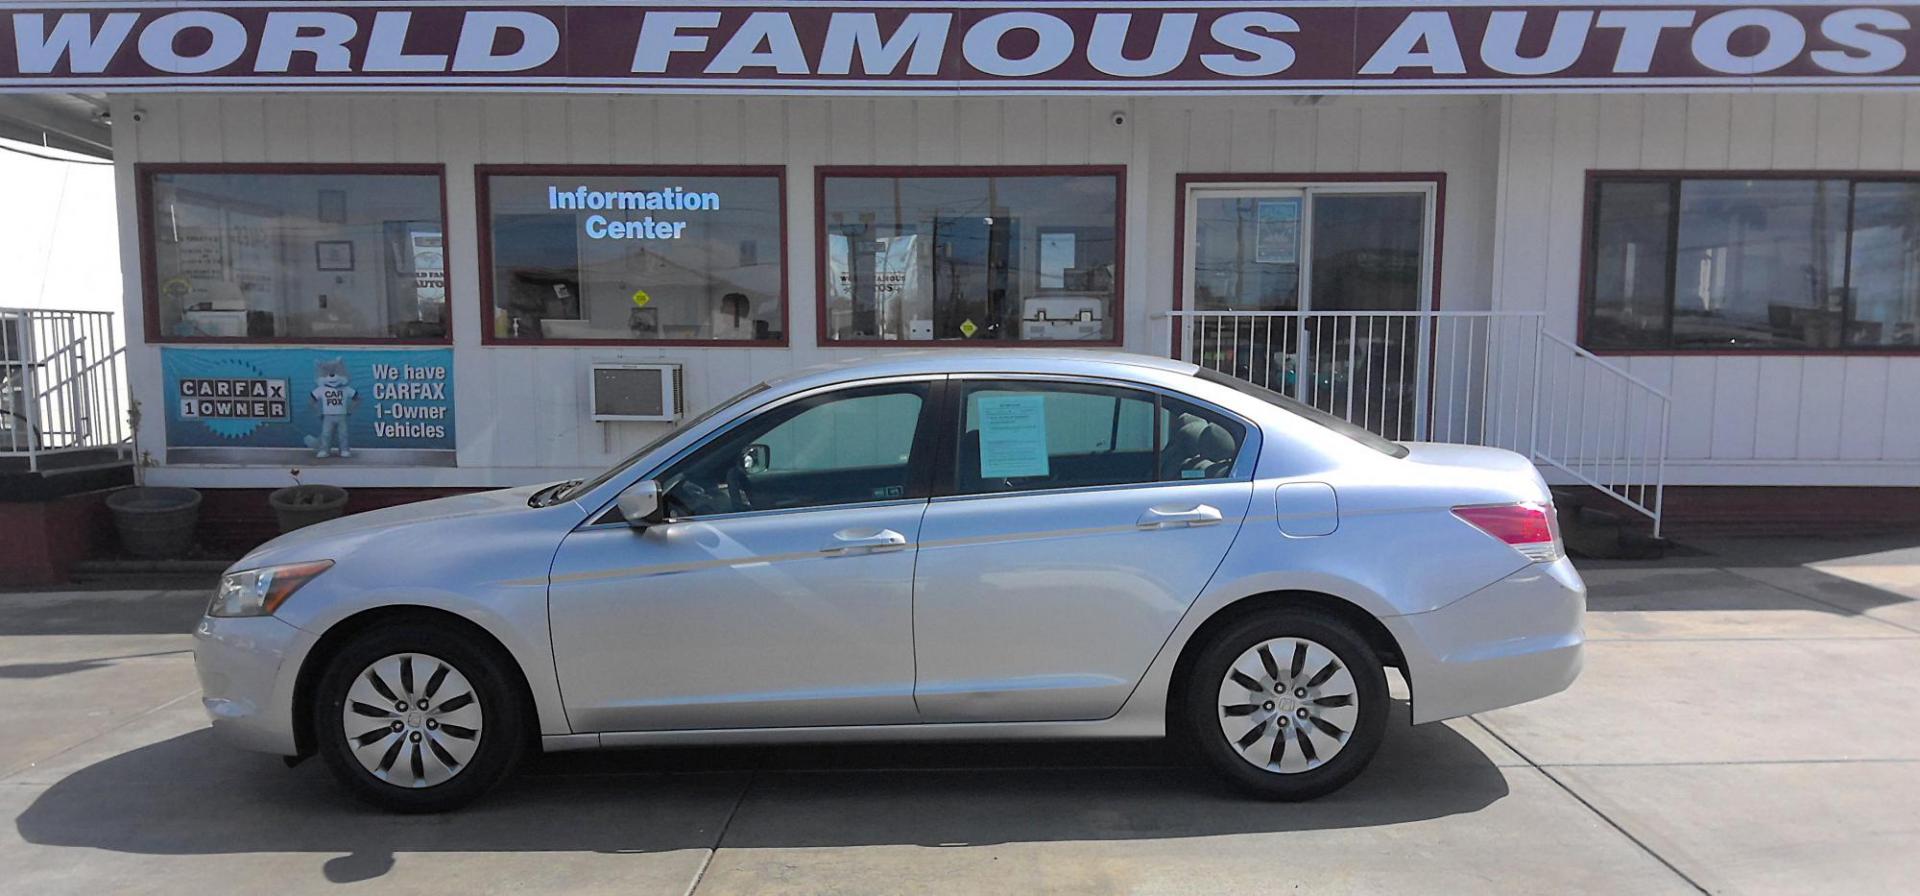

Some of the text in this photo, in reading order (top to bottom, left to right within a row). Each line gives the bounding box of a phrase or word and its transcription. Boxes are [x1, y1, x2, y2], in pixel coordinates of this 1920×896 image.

[12, 8, 1911, 77] WORLD FAMOUS AUTOS
[548, 185, 720, 211] Information
[585, 214, 687, 239] Center
[372, 363, 446, 380] We have
[182, 381, 283, 398] CARFAX
[324, 390, 344, 398] CAR
[372, 382, 445, 400] CARFAX
[185, 402, 284, 416] 1 OWNER
[326, 398, 344, 406] FOX
[373, 402, 447, 419] 1-Owner
[373, 421, 445, 438] Vehicles
